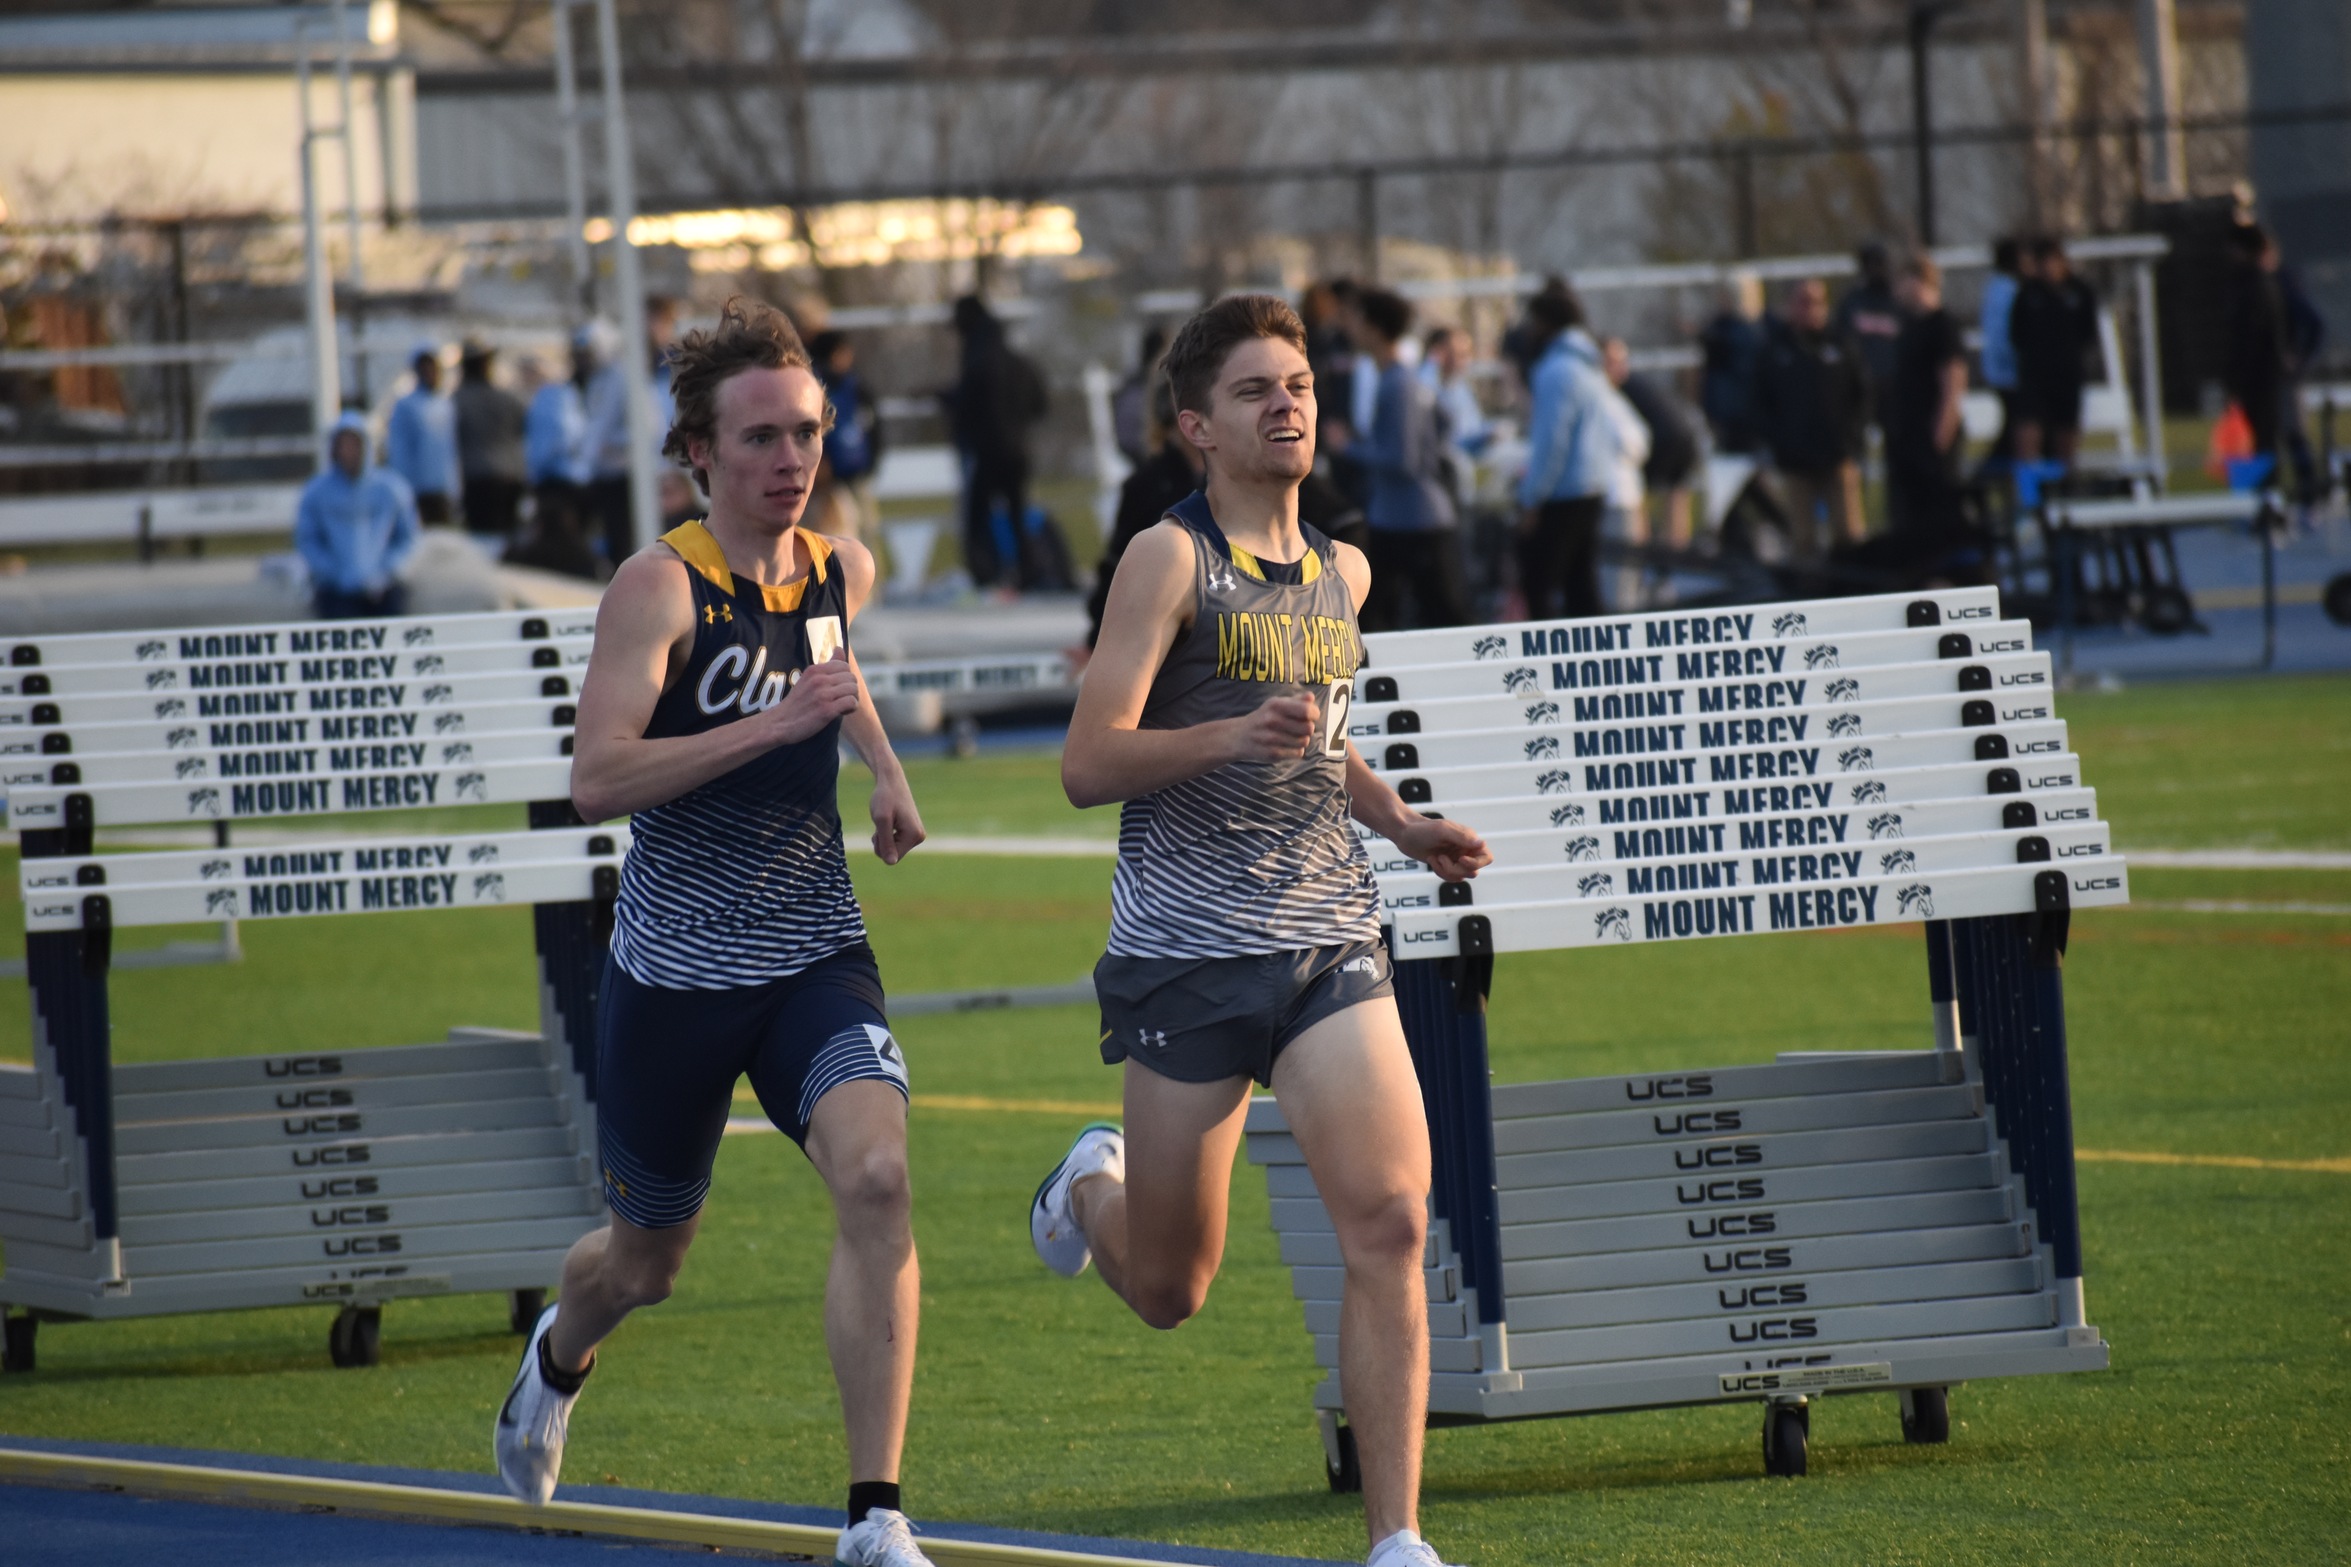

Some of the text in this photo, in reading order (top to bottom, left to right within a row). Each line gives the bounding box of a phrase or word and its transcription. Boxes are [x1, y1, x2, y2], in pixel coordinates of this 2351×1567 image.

[1947, 606, 1992, 619] UCS
[180, 627, 387, 659] MOUNT MERCY
[1521, 614, 1754, 657] MOUNT MERCY
[1980, 640, 2025, 653] UCS
[1216, 611, 1358, 685] MOUNT MERCY
[190, 656, 397, 688] MOUNT MERCY
[1552, 646, 1786, 689] MOUNT MERCY
[2000, 672, 2045, 685] UCS
[199, 685, 406, 717] MOUNT MERCY
[1574, 680, 1807, 722] MOUNT MERCY
[1329, 683, 1350, 751] 2
[2002, 707, 2047, 720] UCS
[211, 713, 417, 747] MOUNT MERCY
[1574, 715, 1808, 757] MOUNT MERCY
[2015, 740, 2061, 754] UCS
[220, 743, 426, 777] MOUNT MERCY
[1585, 748, 1820, 791] MOUNT MERCY
[4, 774, 44, 786] UCS
[2028, 775, 2073, 788] UCS
[232, 773, 439, 815] MOUNT MERCY
[1599, 782, 1833, 824] MOUNT MERCY
[15, 804, 57, 817] UCS
[2044, 808, 2090, 821] UCS
[1614, 814, 1849, 859] MOUNT MERCY
[244, 845, 451, 878] MOUNT MERCY
[2057, 843, 2102, 857] UCS
[1373, 860, 1419, 872] UCS
[1627, 851, 1862, 894] MOUNT MERCY
[28, 876, 69, 888] UCS
[2074, 877, 2120, 891] UCS
[251, 874, 457, 917] MOUNT MERCY
[1385, 896, 1431, 908] UCS
[33, 905, 75, 917] UCS
[1644, 886, 1879, 940] MOUNT MERCY
[1404, 930, 1449, 943] UCS
[264, 1056, 342, 1077] UCS
[275, 1088, 355, 1109] UCS
[1626, 1076, 1713, 1100] UCS
[283, 1114, 362, 1136] UCS
[1654, 1110, 1742, 1135] UCS
[292, 1144, 371, 1167] UCS
[1675, 1145, 1762, 1169] UCS
[300, 1176, 379, 1199] UCS
[1677, 1178, 1765, 1204] UCS
[311, 1205, 389, 1227] UCS
[1688, 1213, 1776, 1238] UCS
[323, 1235, 402, 1257] UCS
[1704, 1247, 1792, 1272] UCS
[1718, 1283, 1807, 1309] UCS
[1729, 1317, 1818, 1343] UCS
[1723, 1375, 1780, 1392] UCS
